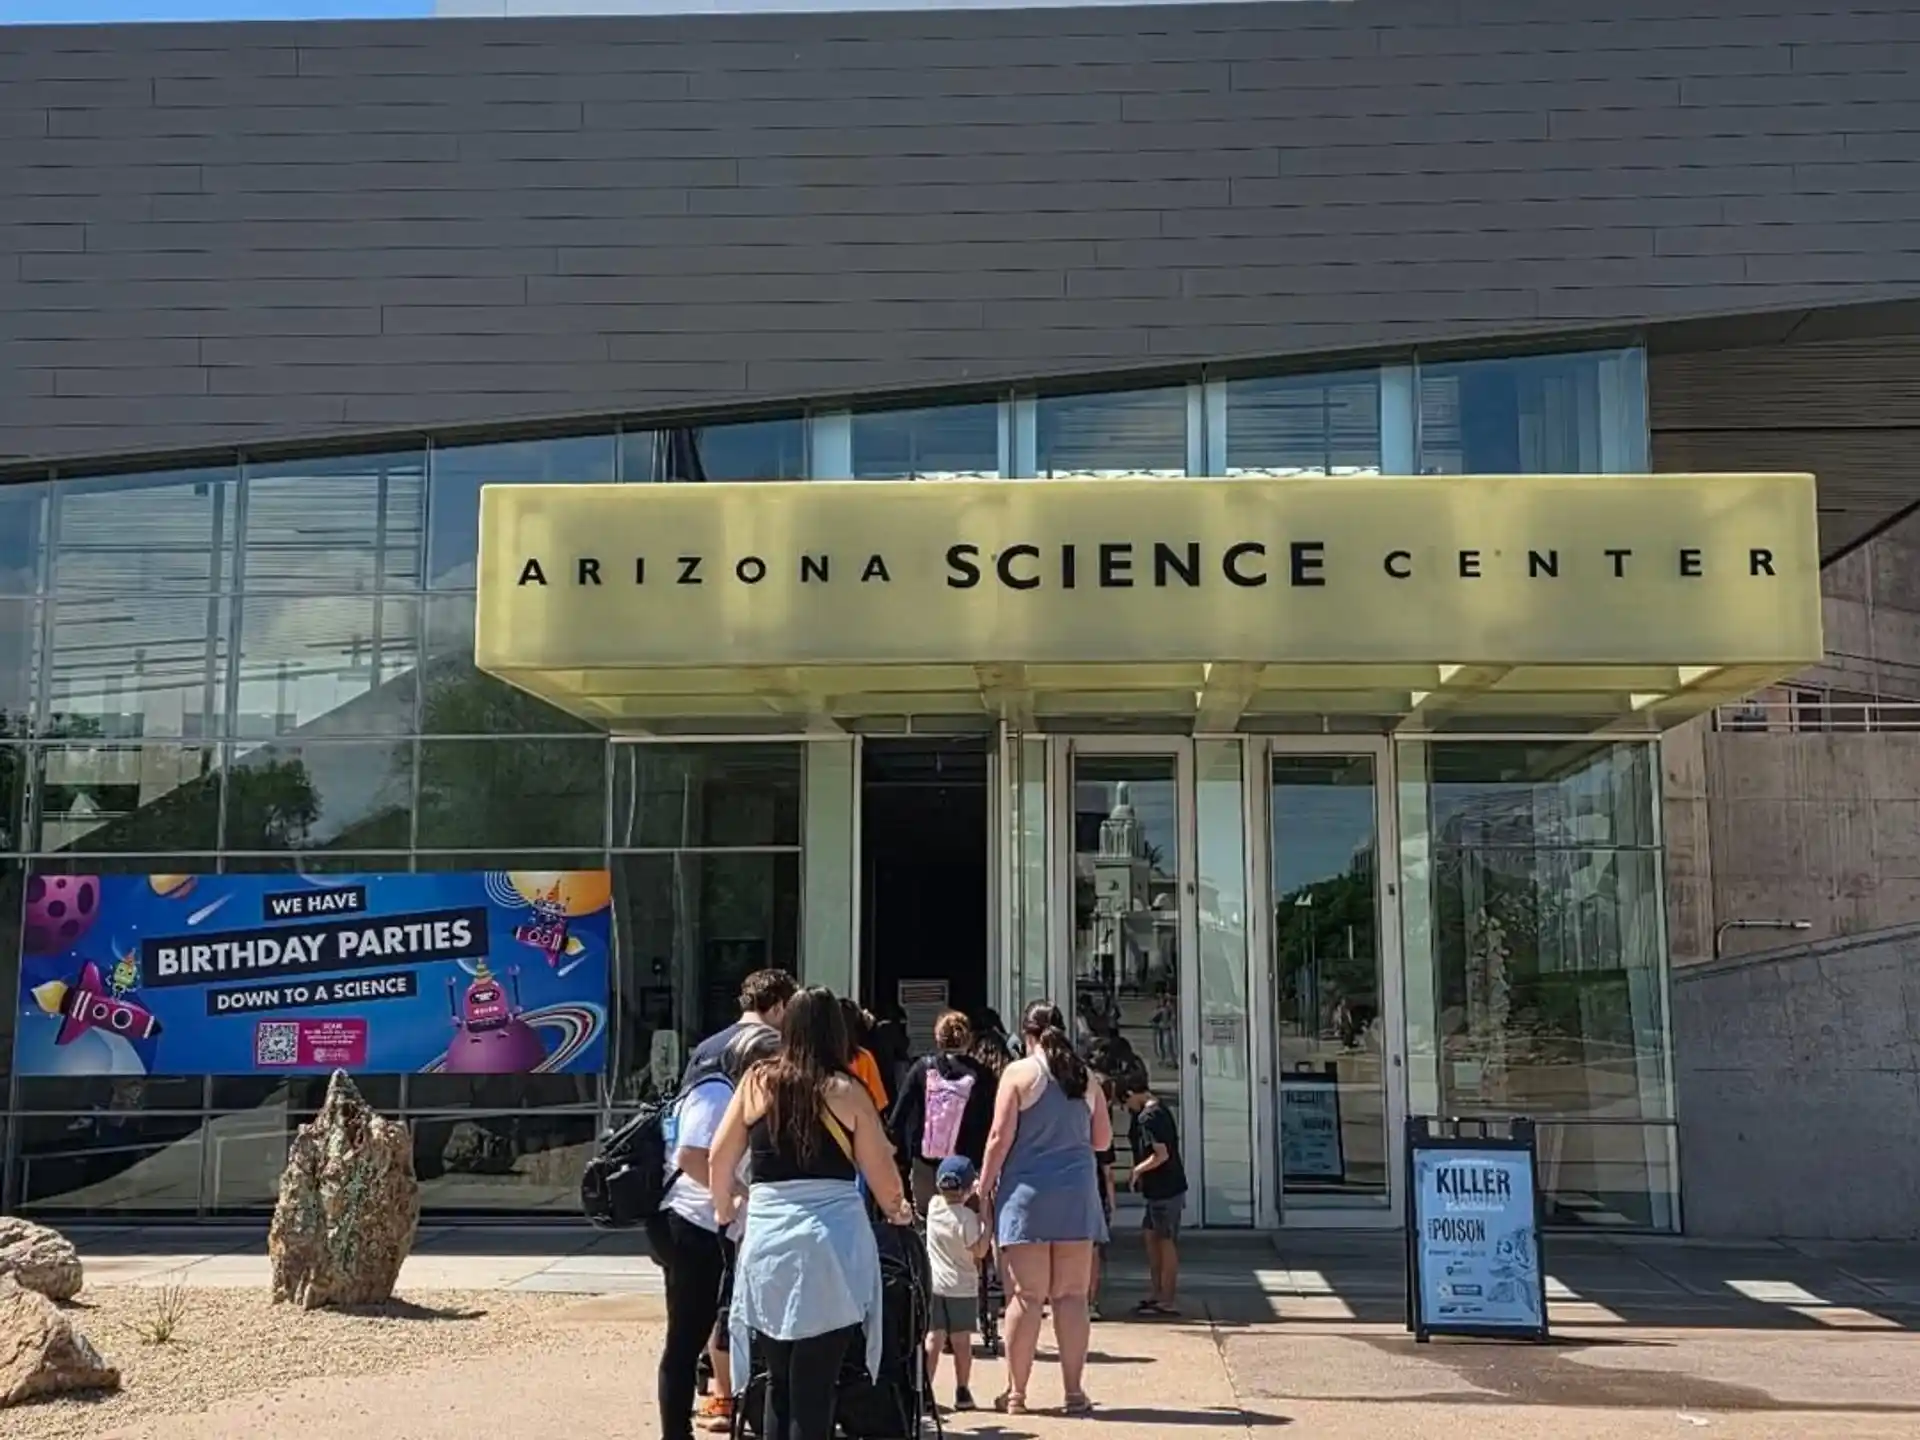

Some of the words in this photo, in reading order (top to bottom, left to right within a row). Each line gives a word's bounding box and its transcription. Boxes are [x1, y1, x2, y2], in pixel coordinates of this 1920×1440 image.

[518, 554, 891, 587] ARIZONA
[946, 541, 1327, 590] SCIENCE
[1383, 549, 1776, 579] CENTER
[271, 899, 302, 916] WE
[307, 892, 358, 912] HAVE
[157, 936, 326, 977] BIRTHDAY
[338, 919, 473, 960] PARTIES
[216, 990, 279, 1011] DOWN
[284, 987, 310, 1004] TO
[314, 985, 329, 1002] A
[333, 977, 407, 1000] SCIENCE
[1436, 1167, 1511, 1202] KILLER
[1433, 1217, 1486, 1243] POISON
